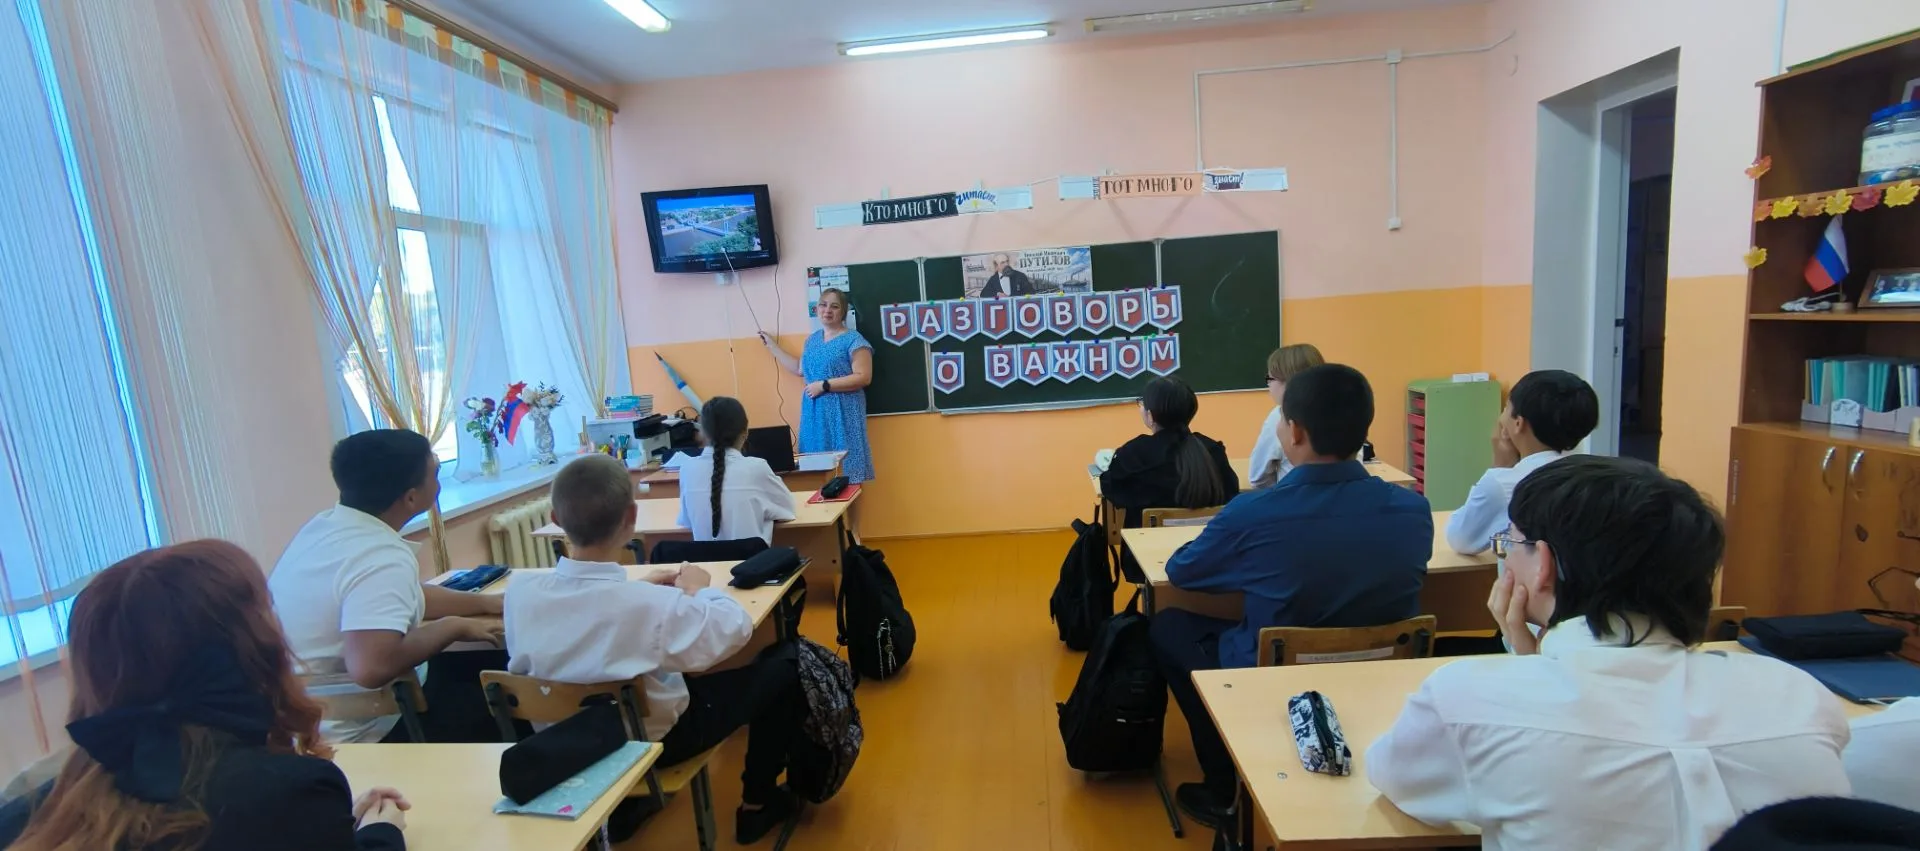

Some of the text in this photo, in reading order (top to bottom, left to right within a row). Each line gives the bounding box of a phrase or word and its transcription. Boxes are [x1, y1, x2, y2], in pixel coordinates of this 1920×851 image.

[1101, 178, 1134, 195] ТОТ
[1138, 177, 1193, 194] МНОГО
[1020, 255, 1071, 269] ПУТИЛОВ
[889, 294, 1179, 336] РАЗГОВОРЫ
[936, 341, 1176, 384] О ВАЖНОМ
